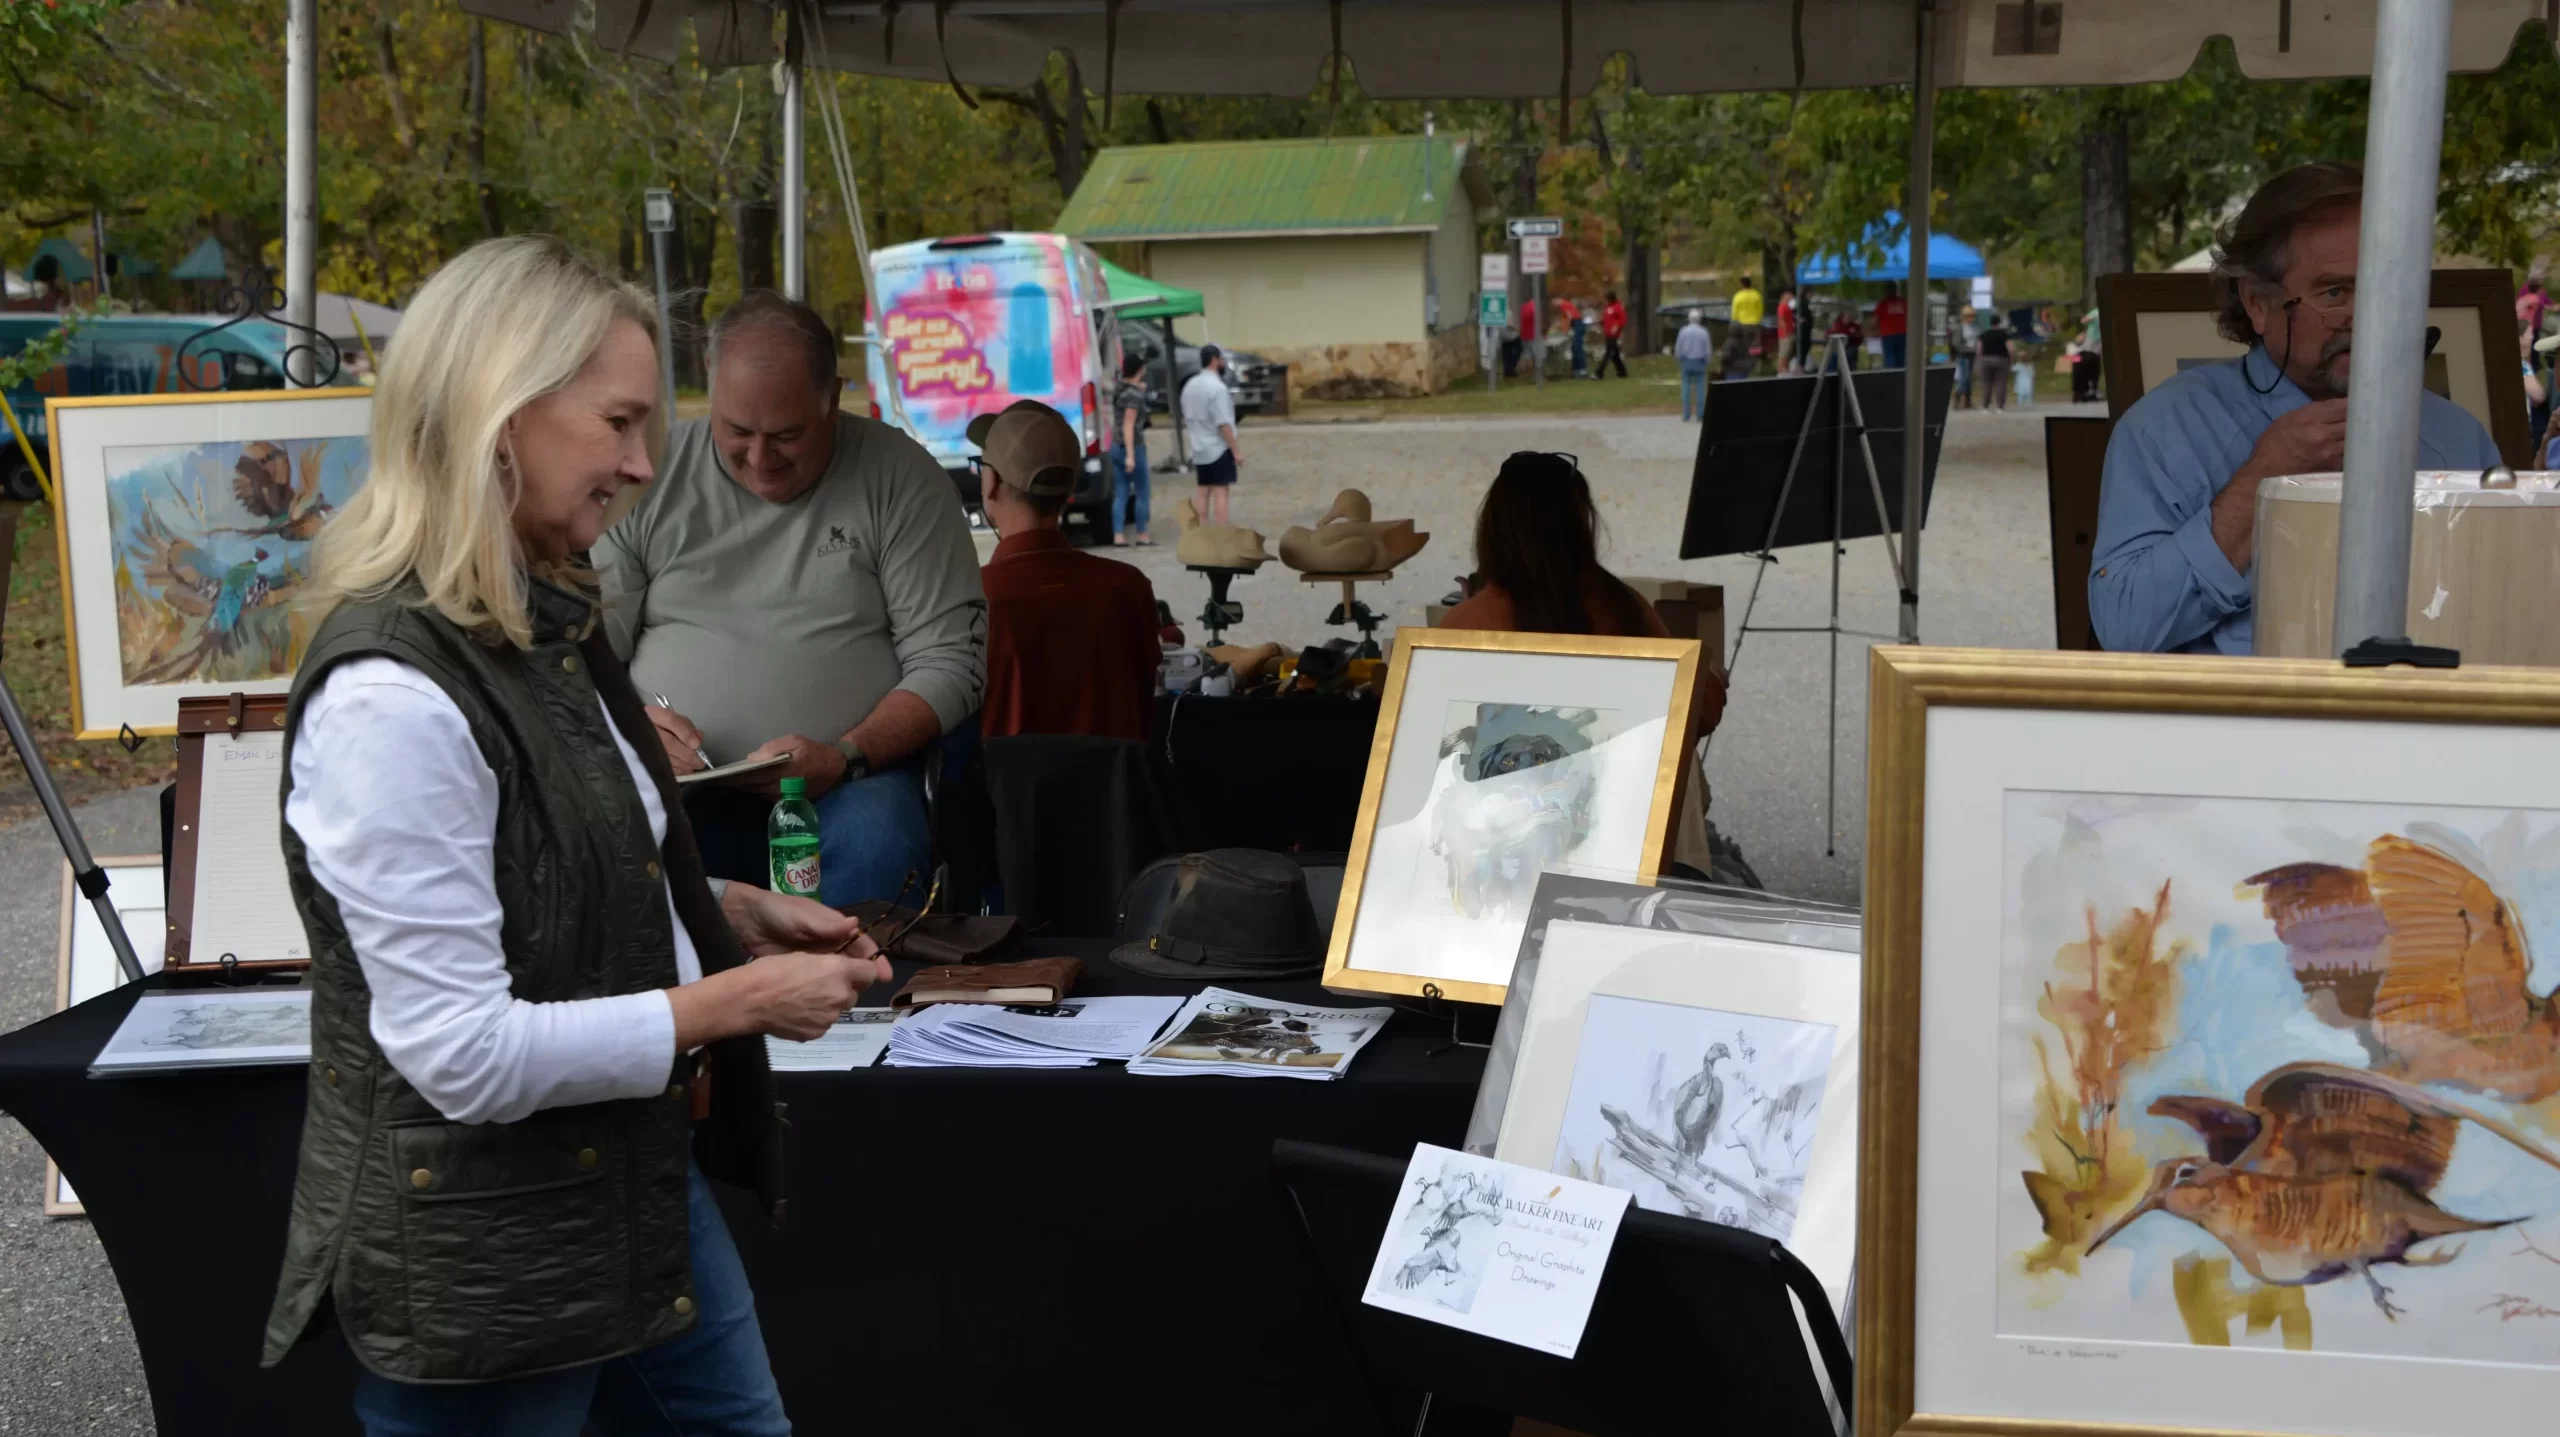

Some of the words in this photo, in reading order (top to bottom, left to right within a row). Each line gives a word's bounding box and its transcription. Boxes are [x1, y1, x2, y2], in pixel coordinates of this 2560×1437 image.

[224, 749, 261, 761] EMAIL
[786, 863, 819, 885] CANA
[1476, 1190, 1501, 1208] DIRK
[1504, 1199, 1552, 1219] WALKER
[1552, 1208, 1579, 1226] FINE
[1580, 1215, 1605, 1232] ART
[1497, 1241, 1539, 1263] Original
[1540, 1250, 1586, 1276] Graphite
[1510, 1265, 1557, 1291] Drawings
